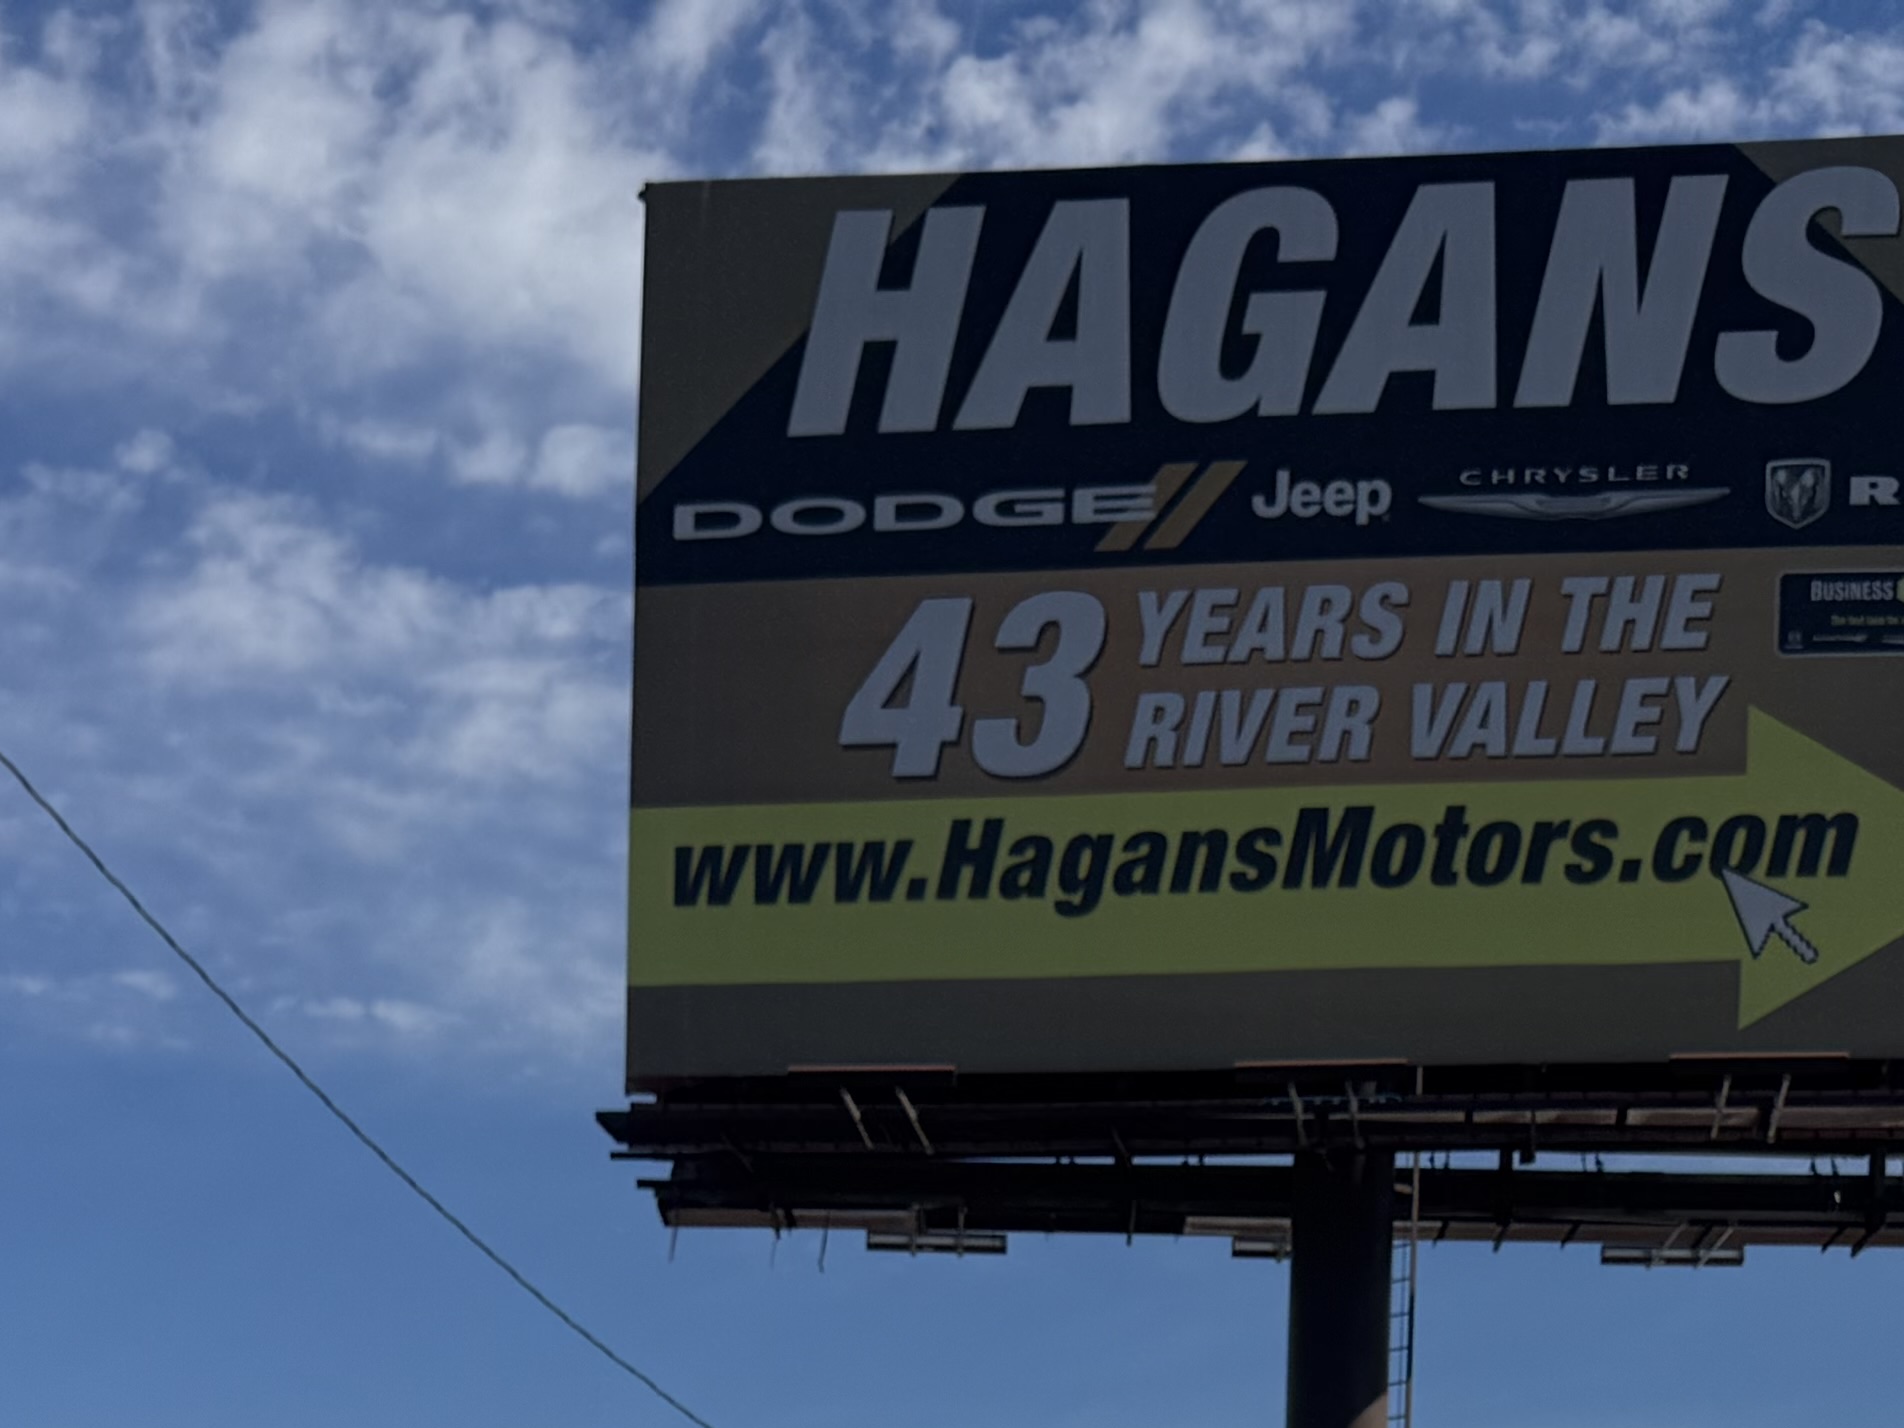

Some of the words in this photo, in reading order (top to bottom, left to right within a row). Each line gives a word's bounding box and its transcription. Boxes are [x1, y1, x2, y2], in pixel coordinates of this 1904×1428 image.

[786, 165, 1902, 438] HAGANS
[672, 483, 1158, 541] DODGE
[1251, 469, 1393, 526] Jeep
[1458, 463, 1691, 488] CHRYSLER
[1138, 580, 1408, 667] YEARS
[1434, 577, 1533, 657] IN
[1559, 572, 1723, 654] THE
[1810, 580, 1895, 601] BUSINESS
[837, 590, 1106, 780] 43
[1125, 684, 1380, 769] RIVER
[1409, 675, 1732, 762] VALLEY
[670, 806, 1861, 917] www.HagansMotors.com
